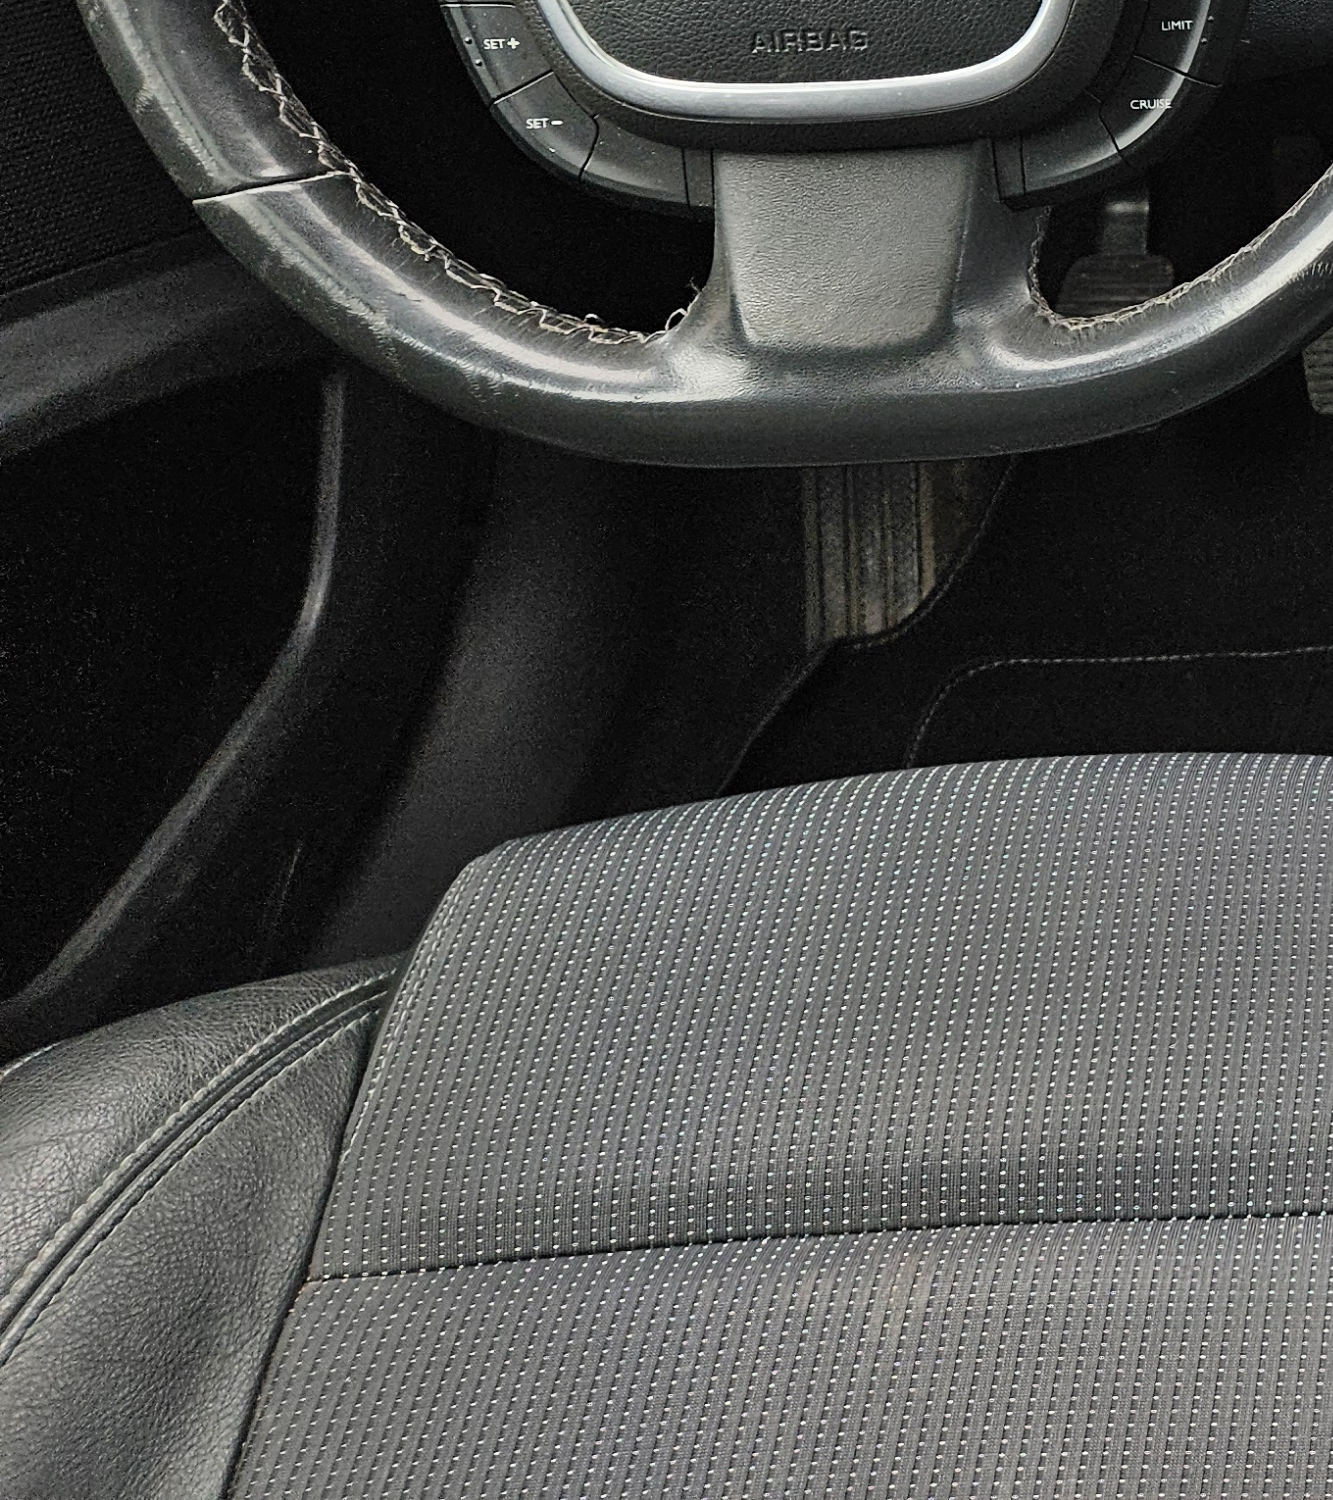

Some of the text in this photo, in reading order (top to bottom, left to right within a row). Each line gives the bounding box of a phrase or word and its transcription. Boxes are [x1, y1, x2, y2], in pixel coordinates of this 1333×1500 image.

[1161, 20, 1194, 31] LIMIT
[751, 30, 869, 54] AIRBAG
[1129, 99, 1172, 110] CRUISE
